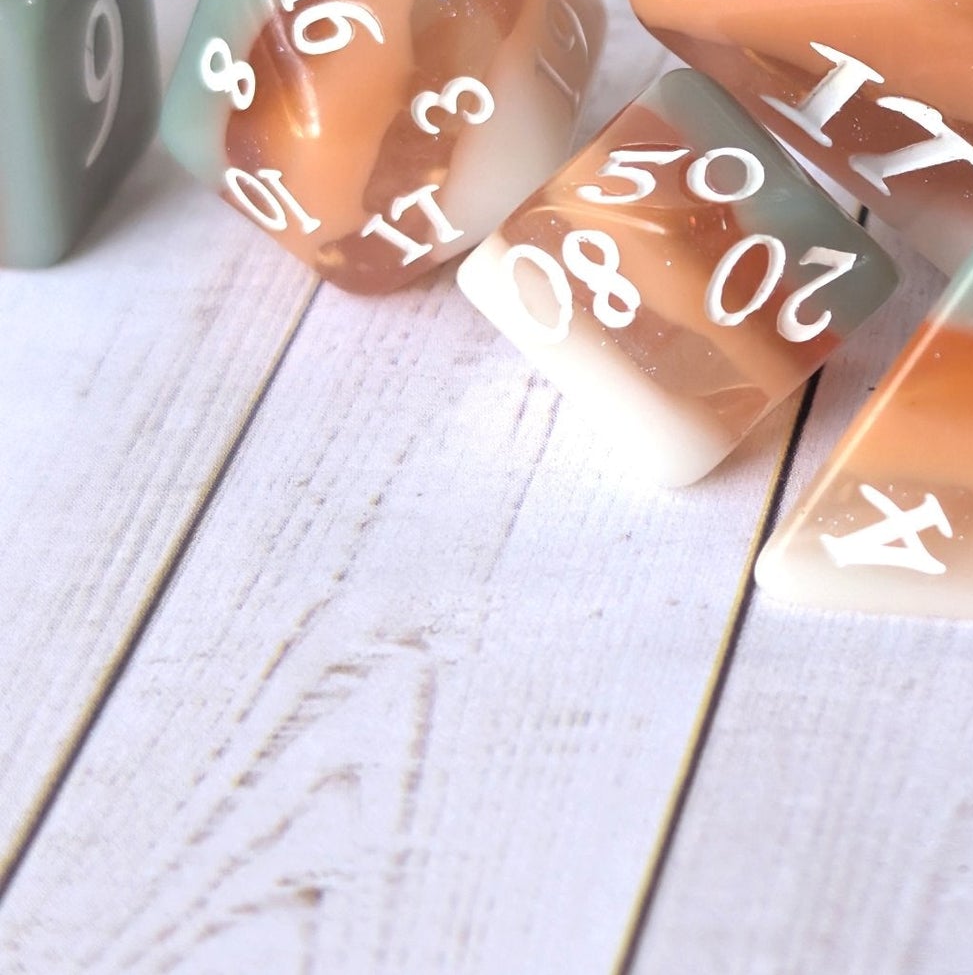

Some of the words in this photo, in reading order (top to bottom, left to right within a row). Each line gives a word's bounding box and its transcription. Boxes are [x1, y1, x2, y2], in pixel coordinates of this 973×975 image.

[201, 37, 256, 112] 8
[410, 76, 494, 135] 3
[225, 167, 322, 234] 10
[576, 147, 765, 204] 50
[500, 229, 641, 345] 80
[704, 233, 858, 343] 20
[819, 483, 953, 575] 4
